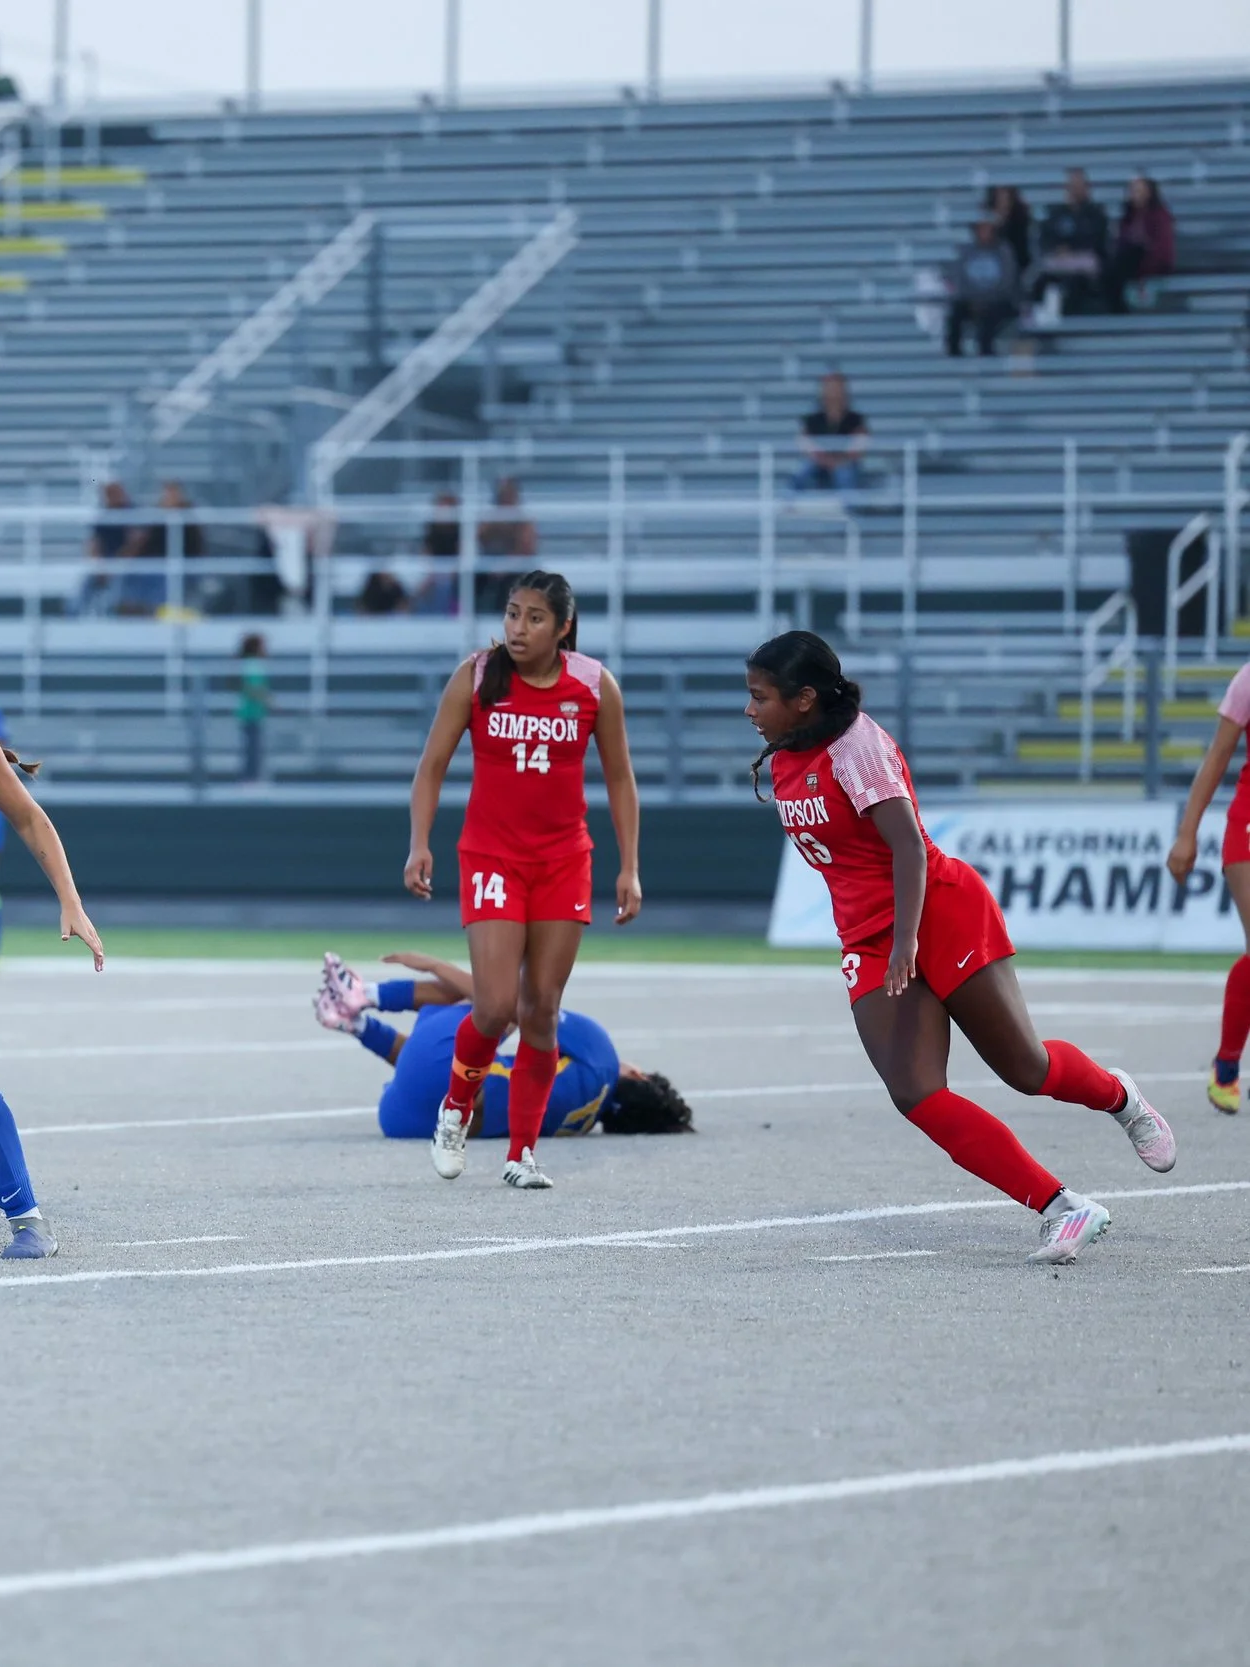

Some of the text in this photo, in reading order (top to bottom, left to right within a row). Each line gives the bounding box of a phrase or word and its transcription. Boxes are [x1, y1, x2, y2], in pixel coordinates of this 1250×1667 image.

[488, 711, 578, 742] SIMPSON
[512, 742, 551, 774] 14
[775, 795, 830, 827] MPSON
[790, 832, 833, 865] 13
[957, 828, 1163, 856] CALIFORNIA
[472, 872, 507, 909] 14
[842, 953, 861, 989] 3
